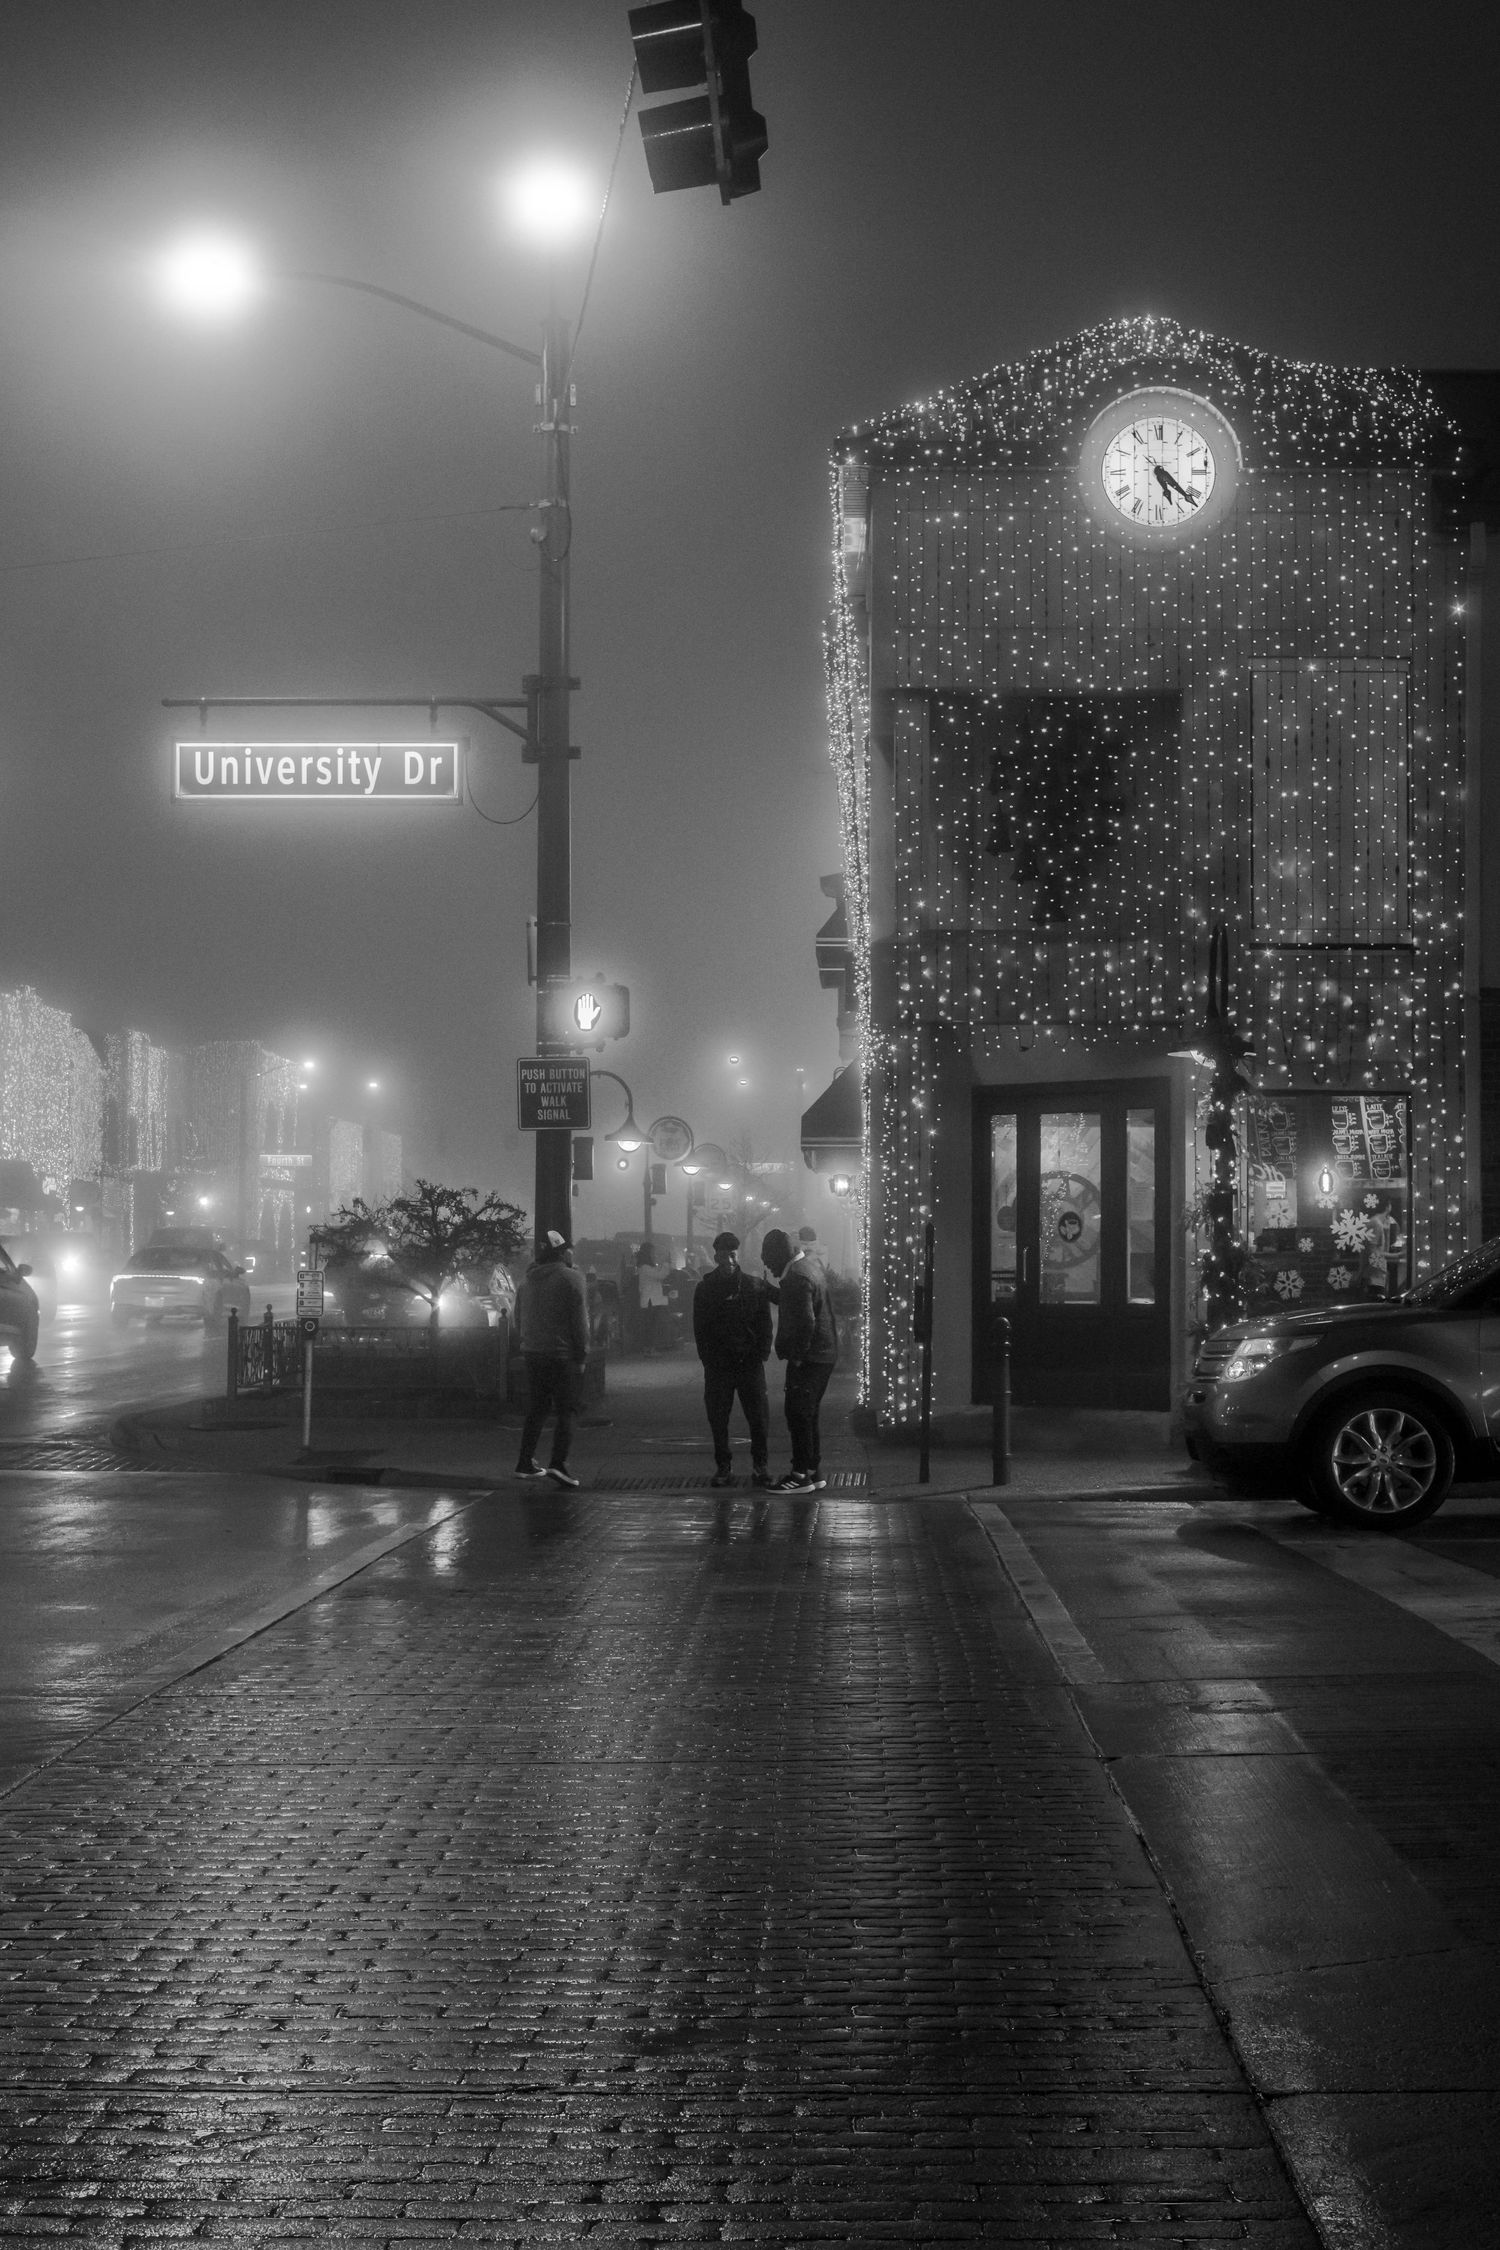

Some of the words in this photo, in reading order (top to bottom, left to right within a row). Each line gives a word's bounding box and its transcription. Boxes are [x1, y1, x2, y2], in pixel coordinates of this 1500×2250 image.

[194, 747, 383, 795] University
[404, 750, 443, 785] Dr
[521, 1068, 545, 1080] PUSH
[549, 1067, 586, 1080] BUTTON
[524, 1082, 537, 1094] TO
[540, 1081, 584, 1094] ACTIVATE
[540, 1095, 567, 1107] WALK
[537, 1108, 572, 1120] SIGNAL
[710, 1198, 732, 1210] 25
